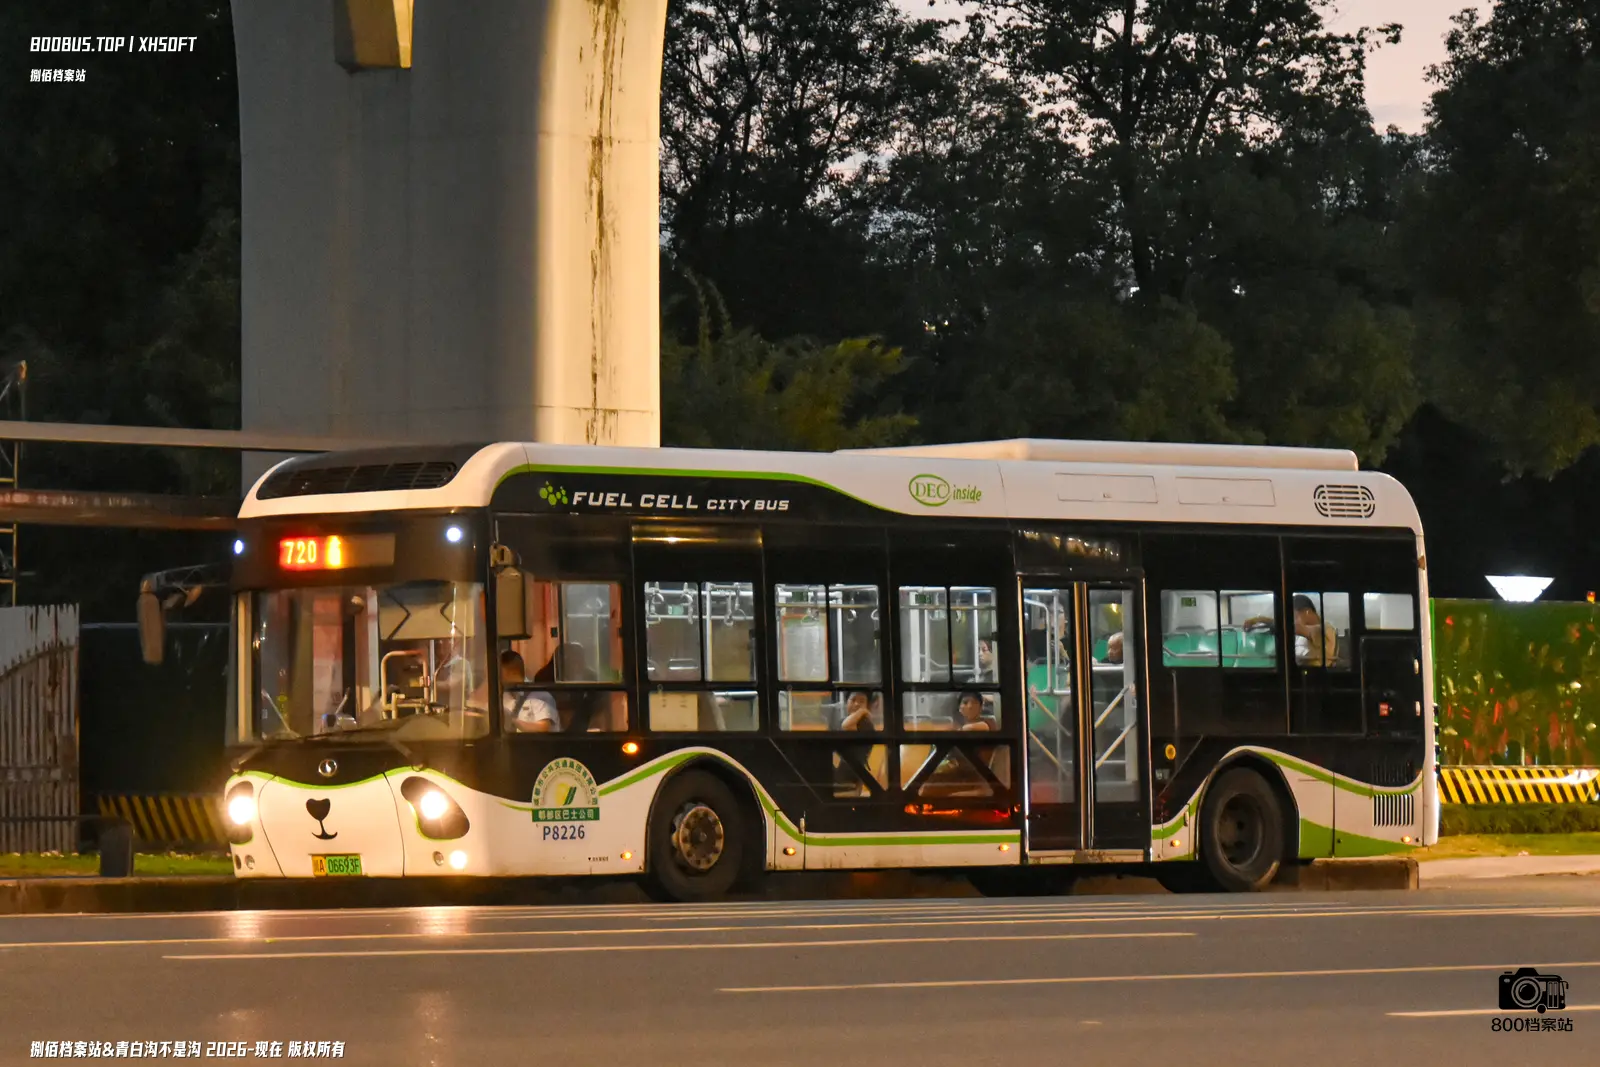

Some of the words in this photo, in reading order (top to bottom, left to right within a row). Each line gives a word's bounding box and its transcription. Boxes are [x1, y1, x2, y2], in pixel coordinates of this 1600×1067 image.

[572, 491, 633, 507] FUEL
[640, 494, 699, 509] CELL
[707, 499, 750, 510] CITY
[754, 500, 790, 511] BUS
[915, 482, 948, 499] DEC
[952, 484, 982, 501] inside
[283, 540, 317, 565] 720
[543, 825, 586, 841] P8226
